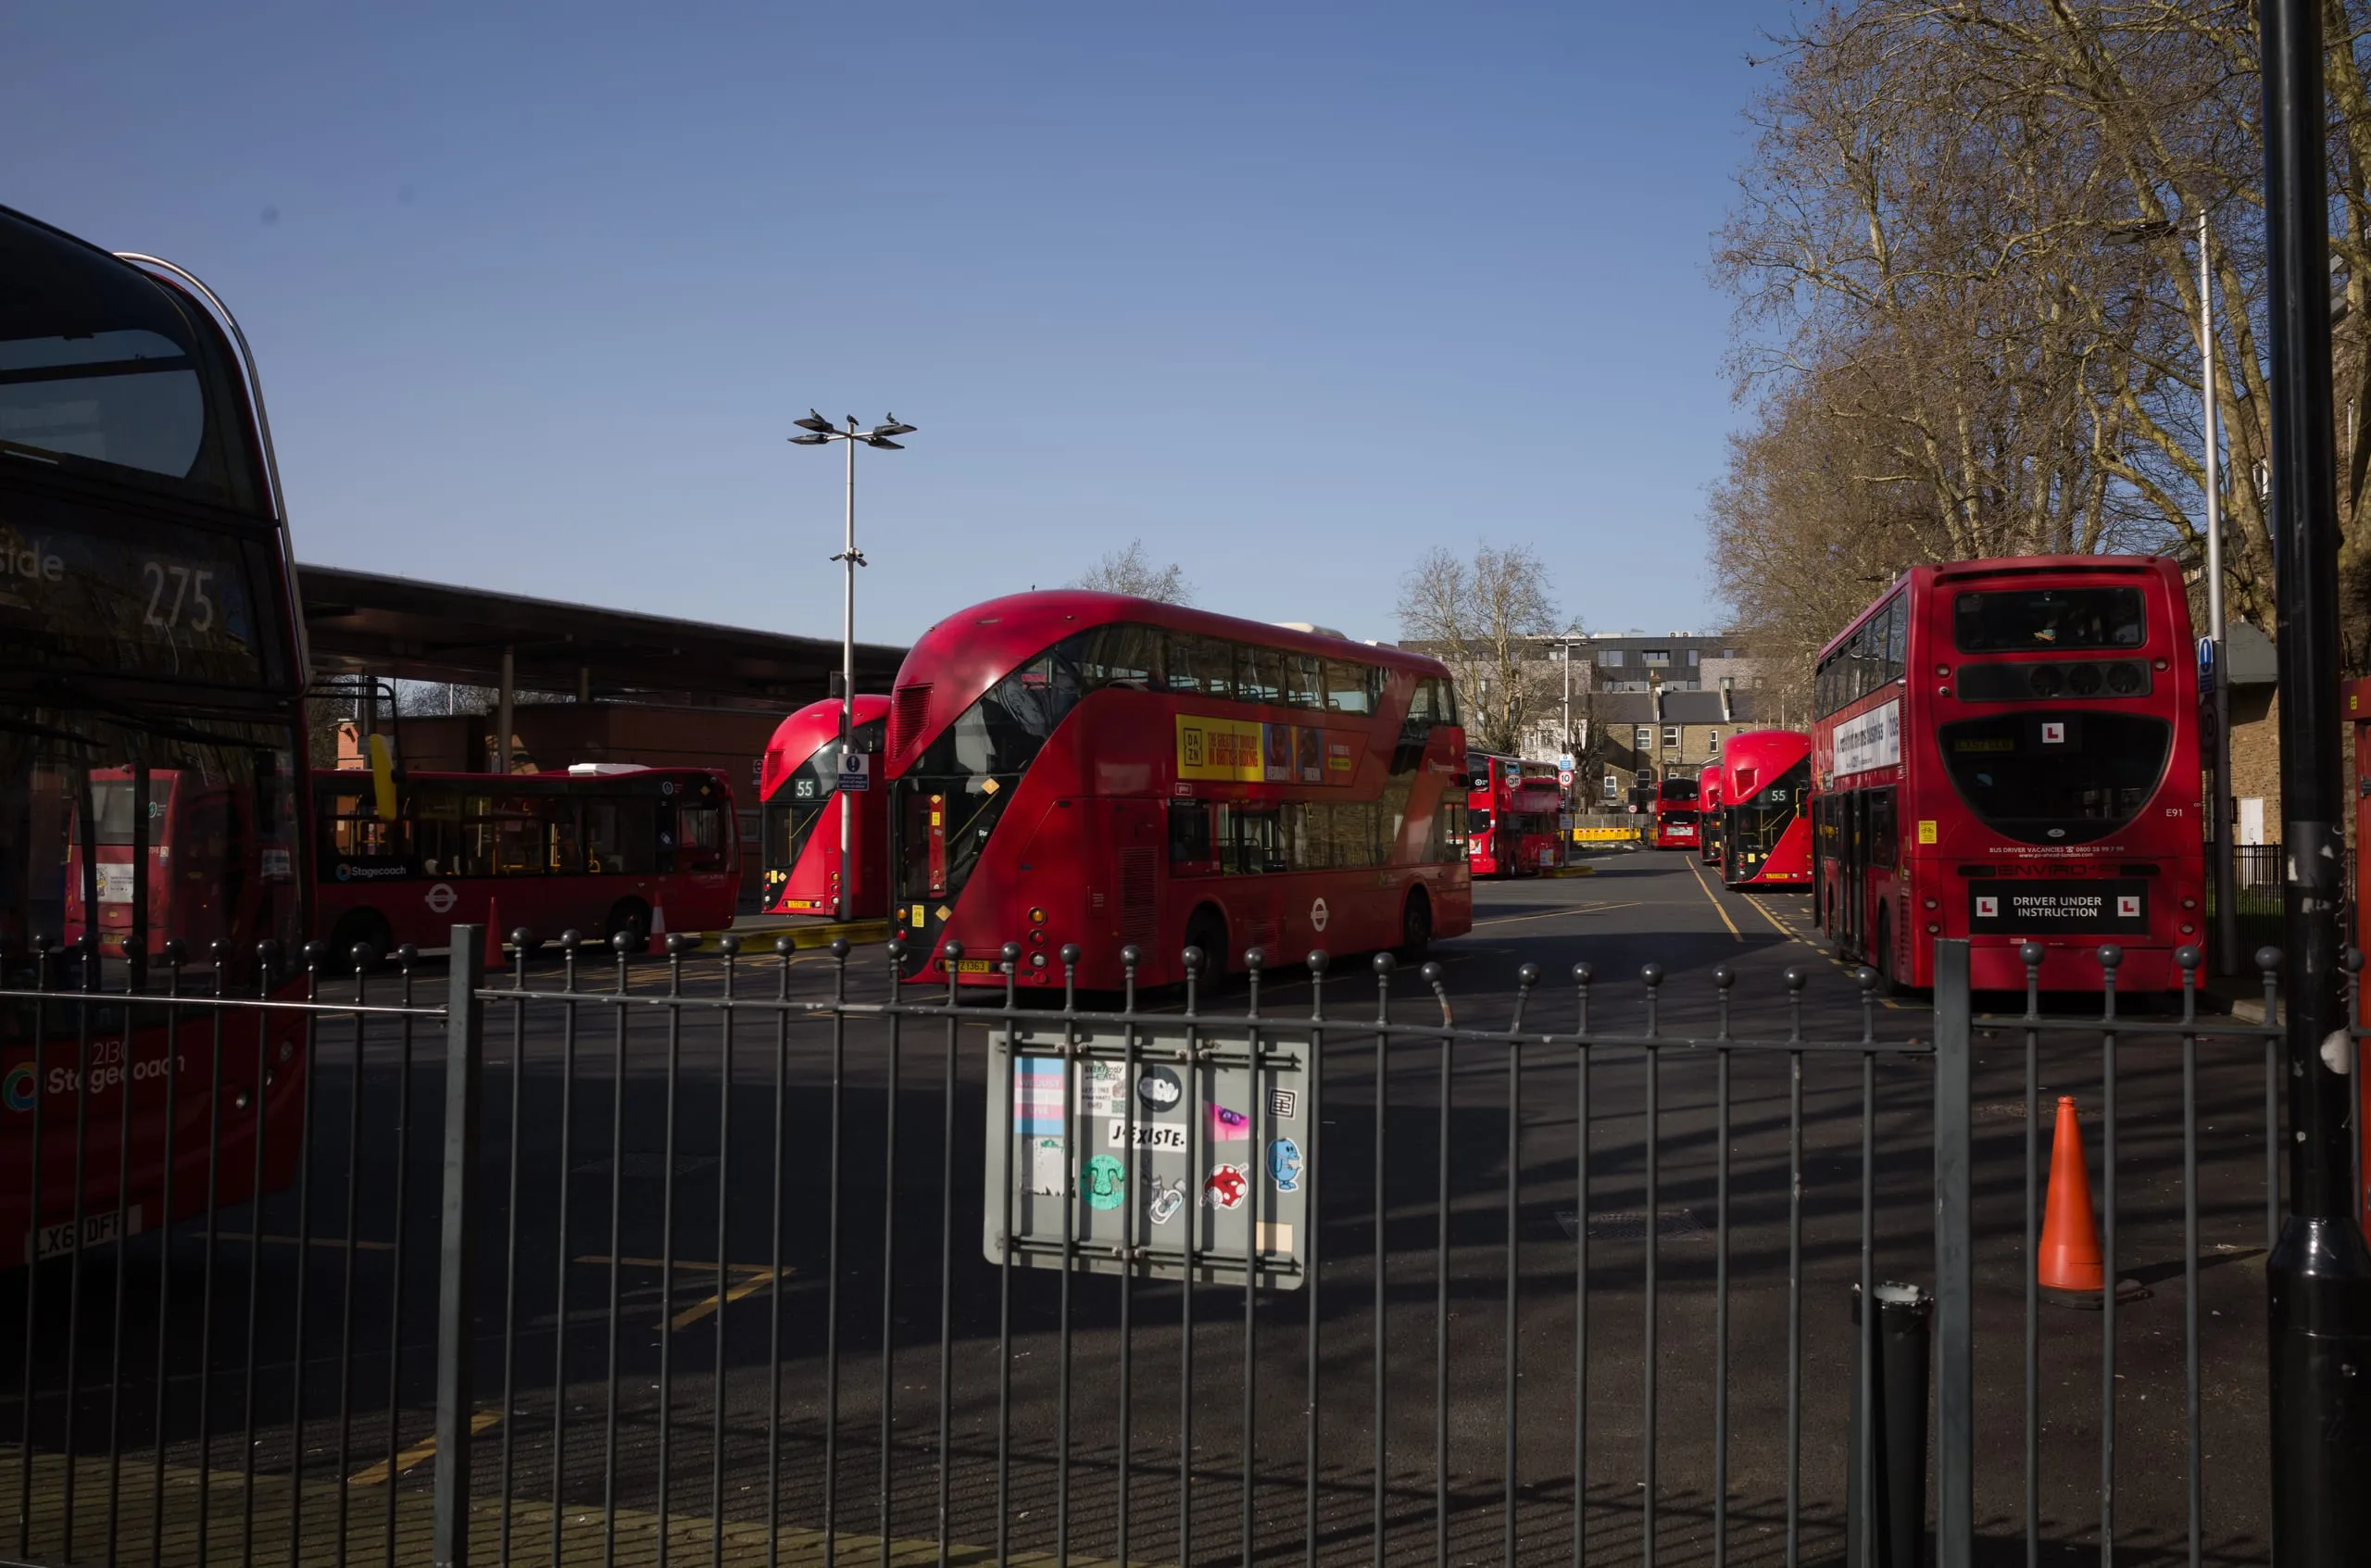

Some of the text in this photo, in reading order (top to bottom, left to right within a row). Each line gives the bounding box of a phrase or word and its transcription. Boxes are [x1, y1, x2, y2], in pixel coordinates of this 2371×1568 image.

[143, 561, 215, 632] 275
[2048, 728, 2058, 738] L
[797, 781, 813, 797] 55
[1771, 790, 1786, 801] 55
[2165, 809, 2182, 817] E91
[352, 865, 407, 878] Stagecoach
[2013, 897, 2102, 906] DRIVER UNDER
[2124, 901, 2134, 911] L
[1982, 902, 1992, 912] L
[2018, 908, 2098, 917] INSTRUCTION
[93, 1041, 126, 1065] 213
[37, 1224, 75, 1254] LX6
